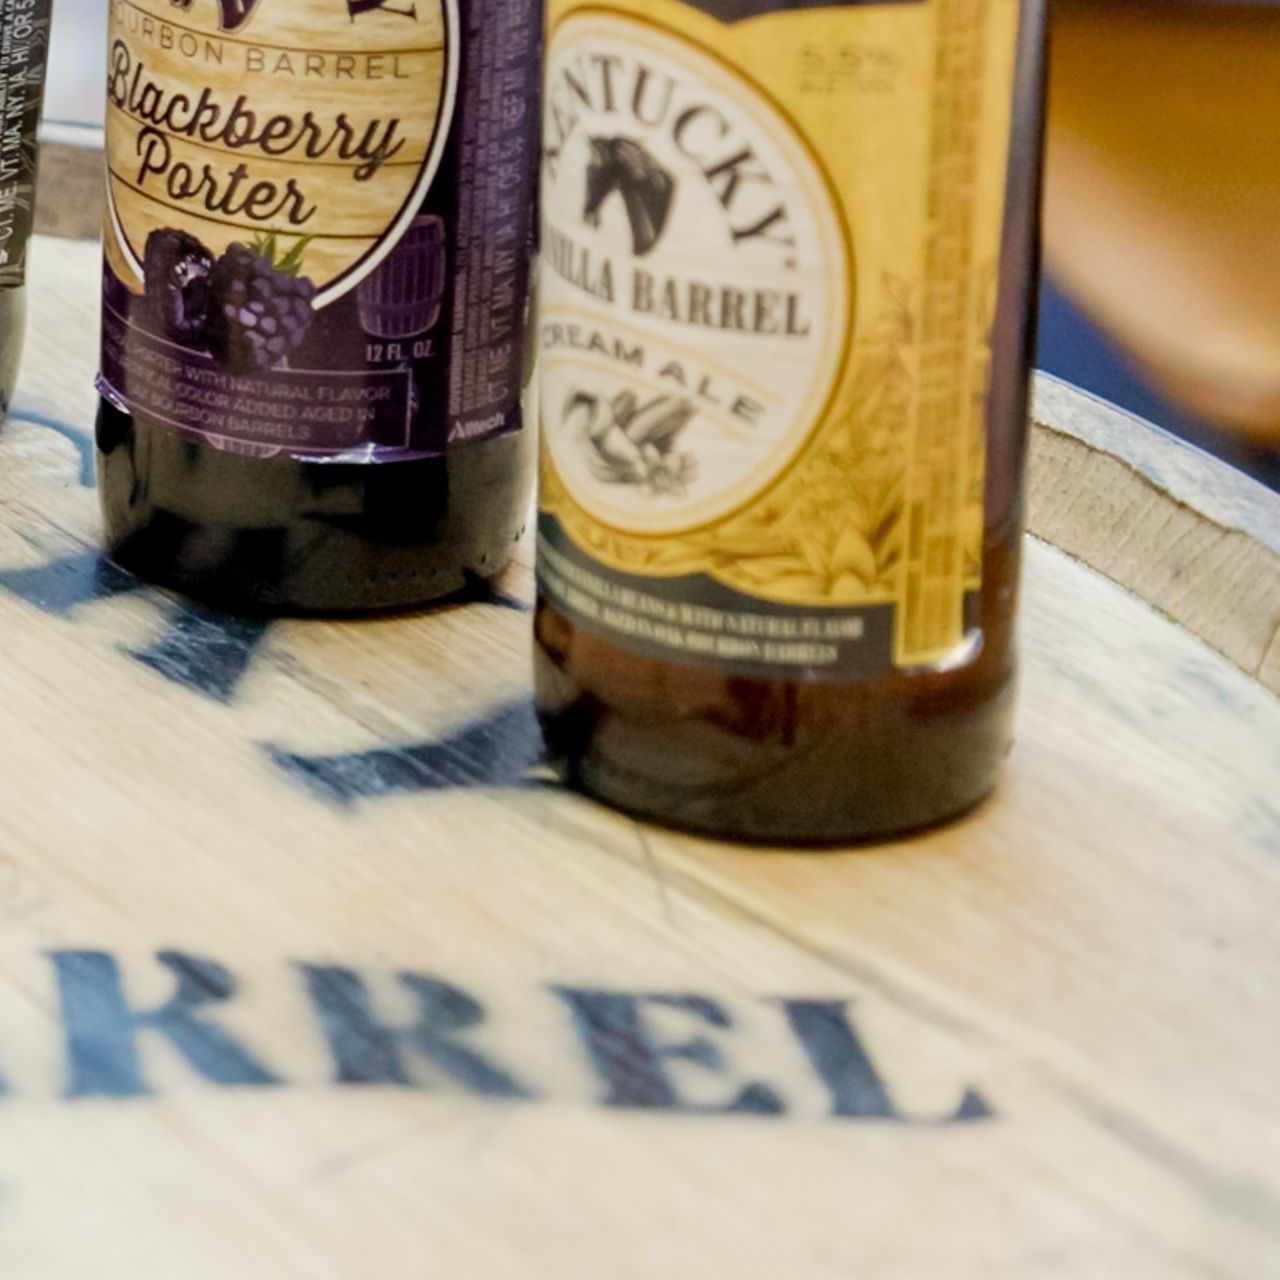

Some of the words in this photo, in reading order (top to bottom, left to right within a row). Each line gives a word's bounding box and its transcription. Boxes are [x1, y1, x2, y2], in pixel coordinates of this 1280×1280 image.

[14, 12, 35, 39] OR
[245, 50, 410, 80] BARREL
[108, 40, 408, 182] Blackberry
[136, 126, 319, 227] Porter
[632, 264, 811, 338] BARREL
[366, 343, 383, 362] 12
[175, 381, 230, 407] COLOR
[233, 399, 299, 419] ADDED
[304, 406, 353, 422] AGED
[358, 407, 376, 420] IN
[185, 366, 229, 390] WITH
[230, 376, 312, 399] NATURAL
[316, 386, 391, 402] FLAVOR
[659, 360, 766, 424] ALE
[228, 415, 312, 438] BARRELS
